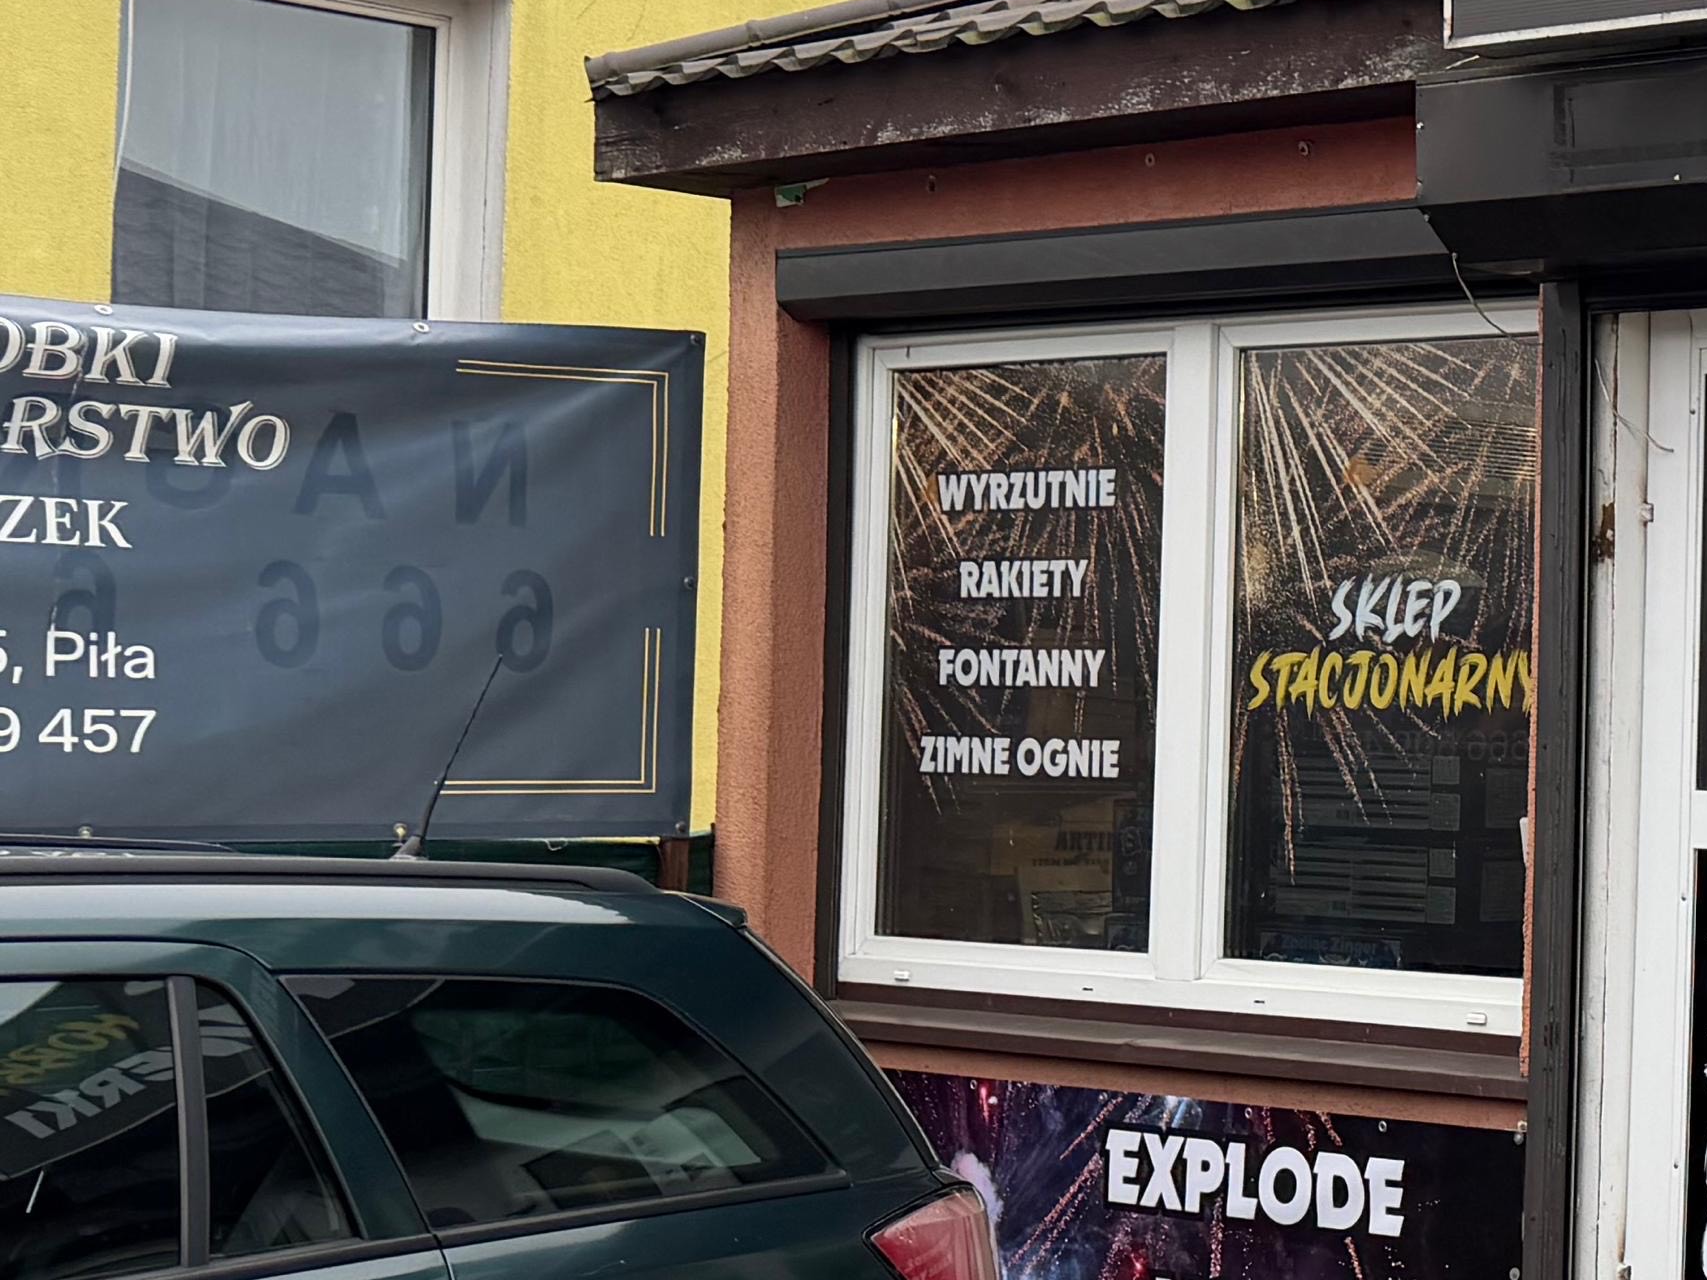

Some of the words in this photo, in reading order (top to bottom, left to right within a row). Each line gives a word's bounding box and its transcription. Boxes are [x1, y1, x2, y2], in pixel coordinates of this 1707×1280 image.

[937, 469, 1116, 512] WYRZUTNIE
[959, 559, 1088, 599] RAKIETY
[1329, 576, 1462, 644] SKLEP
[46, 631, 155, 678] Piła
[938, 649, 1106, 689] FONTANNY
[38, 708, 157, 753] 457
[920, 735, 1010, 775] ZIMNE
[1017, 739, 1120, 778] OGNIE
[1105, 1128, 1405, 1237] EXPLODE
